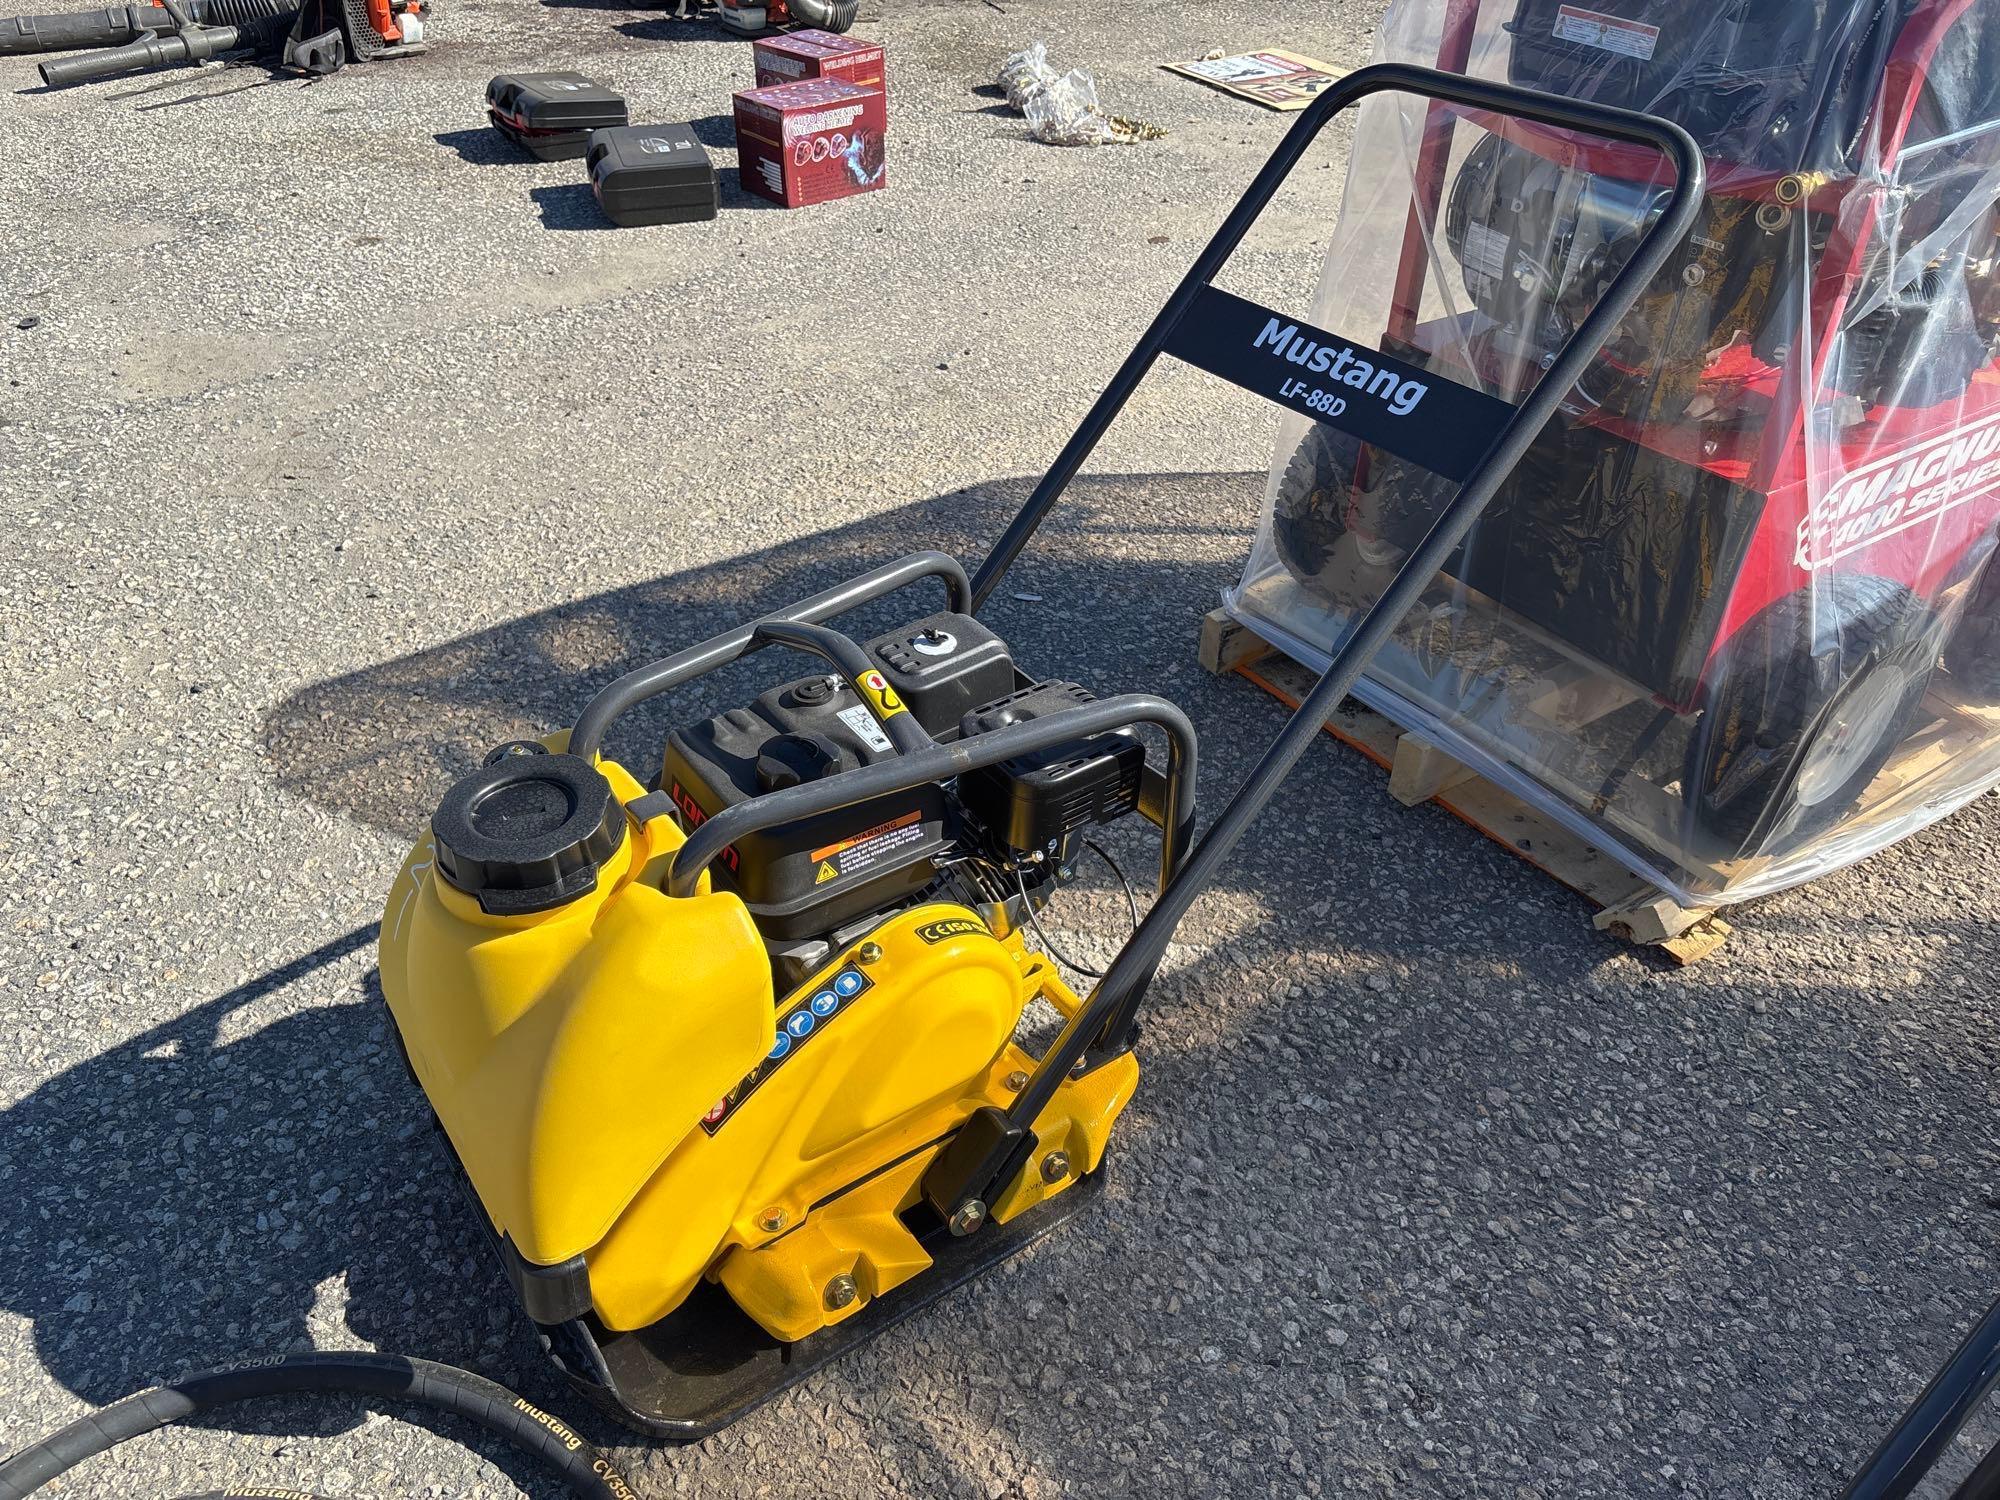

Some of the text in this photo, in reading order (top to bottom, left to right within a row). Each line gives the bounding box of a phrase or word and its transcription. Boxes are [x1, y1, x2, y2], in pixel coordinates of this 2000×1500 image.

[793, 104, 864, 125] AUTO DARKENING
[1253, 317, 1429, 416] Mustang
[1279, 377, 1347, 417] LF-88D
[1838, 424, 2000, 515] MAGNU
[852, 821, 897, 843] WARNING
[839, 848, 856, 858] Check
[857, 842, 869, 850] that
[868, 837, 883, 846] there
[852, 854, 870, 864] before
[905, 832, 924, 842] engine
[213, 1354, 287, 1374] CV3500
[513, 1398, 582, 1451] Mustang
[223, 1486, 314, 1500] Mustang
